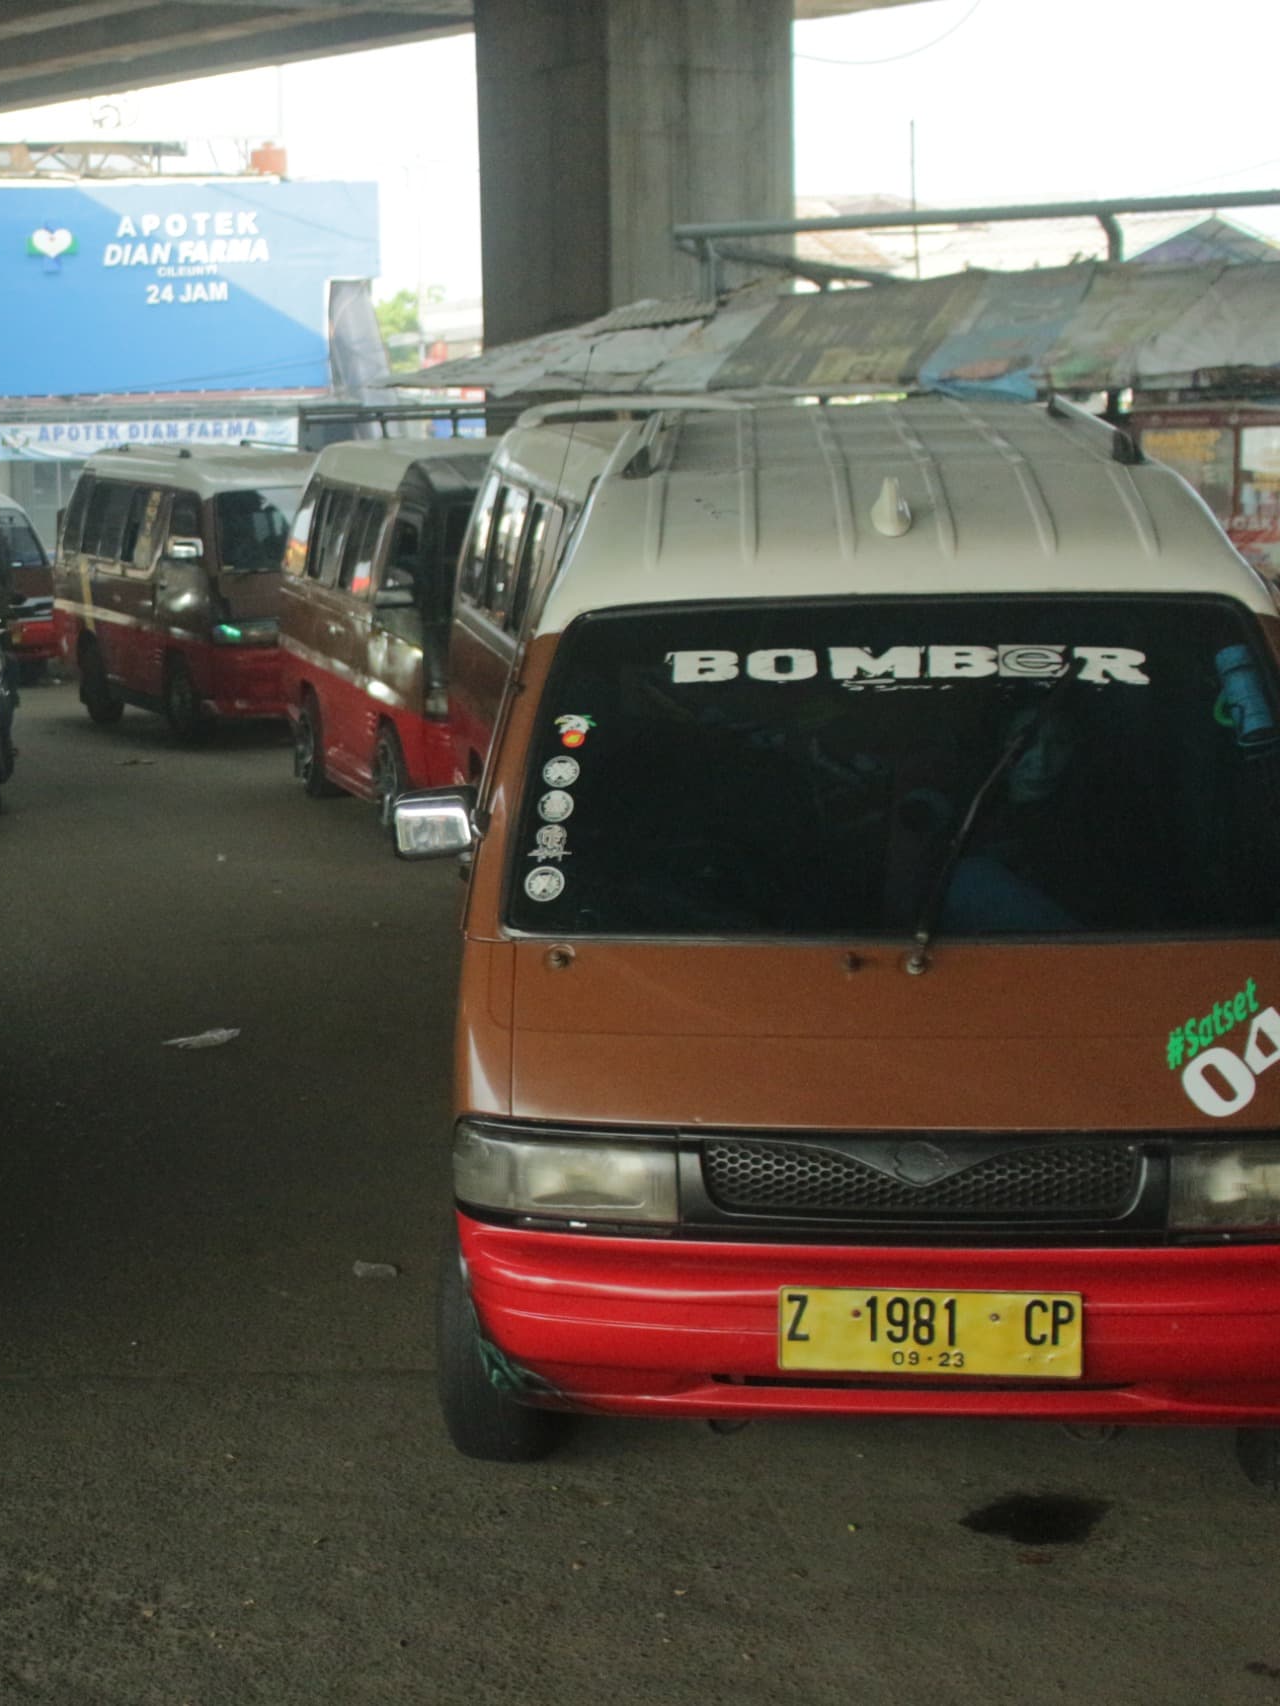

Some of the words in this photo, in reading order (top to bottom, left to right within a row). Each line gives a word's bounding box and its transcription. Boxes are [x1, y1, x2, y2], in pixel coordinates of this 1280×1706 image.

[116, 211, 260, 238] APOTEK
[103, 242, 172, 267] DIAN
[177, 238, 270, 264] FARMA
[146, 283, 175, 304] 24
[179, 281, 228, 303] JAM
[37, 425, 120, 442] APOTEK
[128, 422, 178, 439] DIAN
[187, 420, 257, 438] FARMA
[1167, 977, 1259, 1070] #Satset
[786, 1294, 810, 1342] Z
[865, 1295, 957, 1347] 1981
[1024, 1299, 1075, 1346] CP
